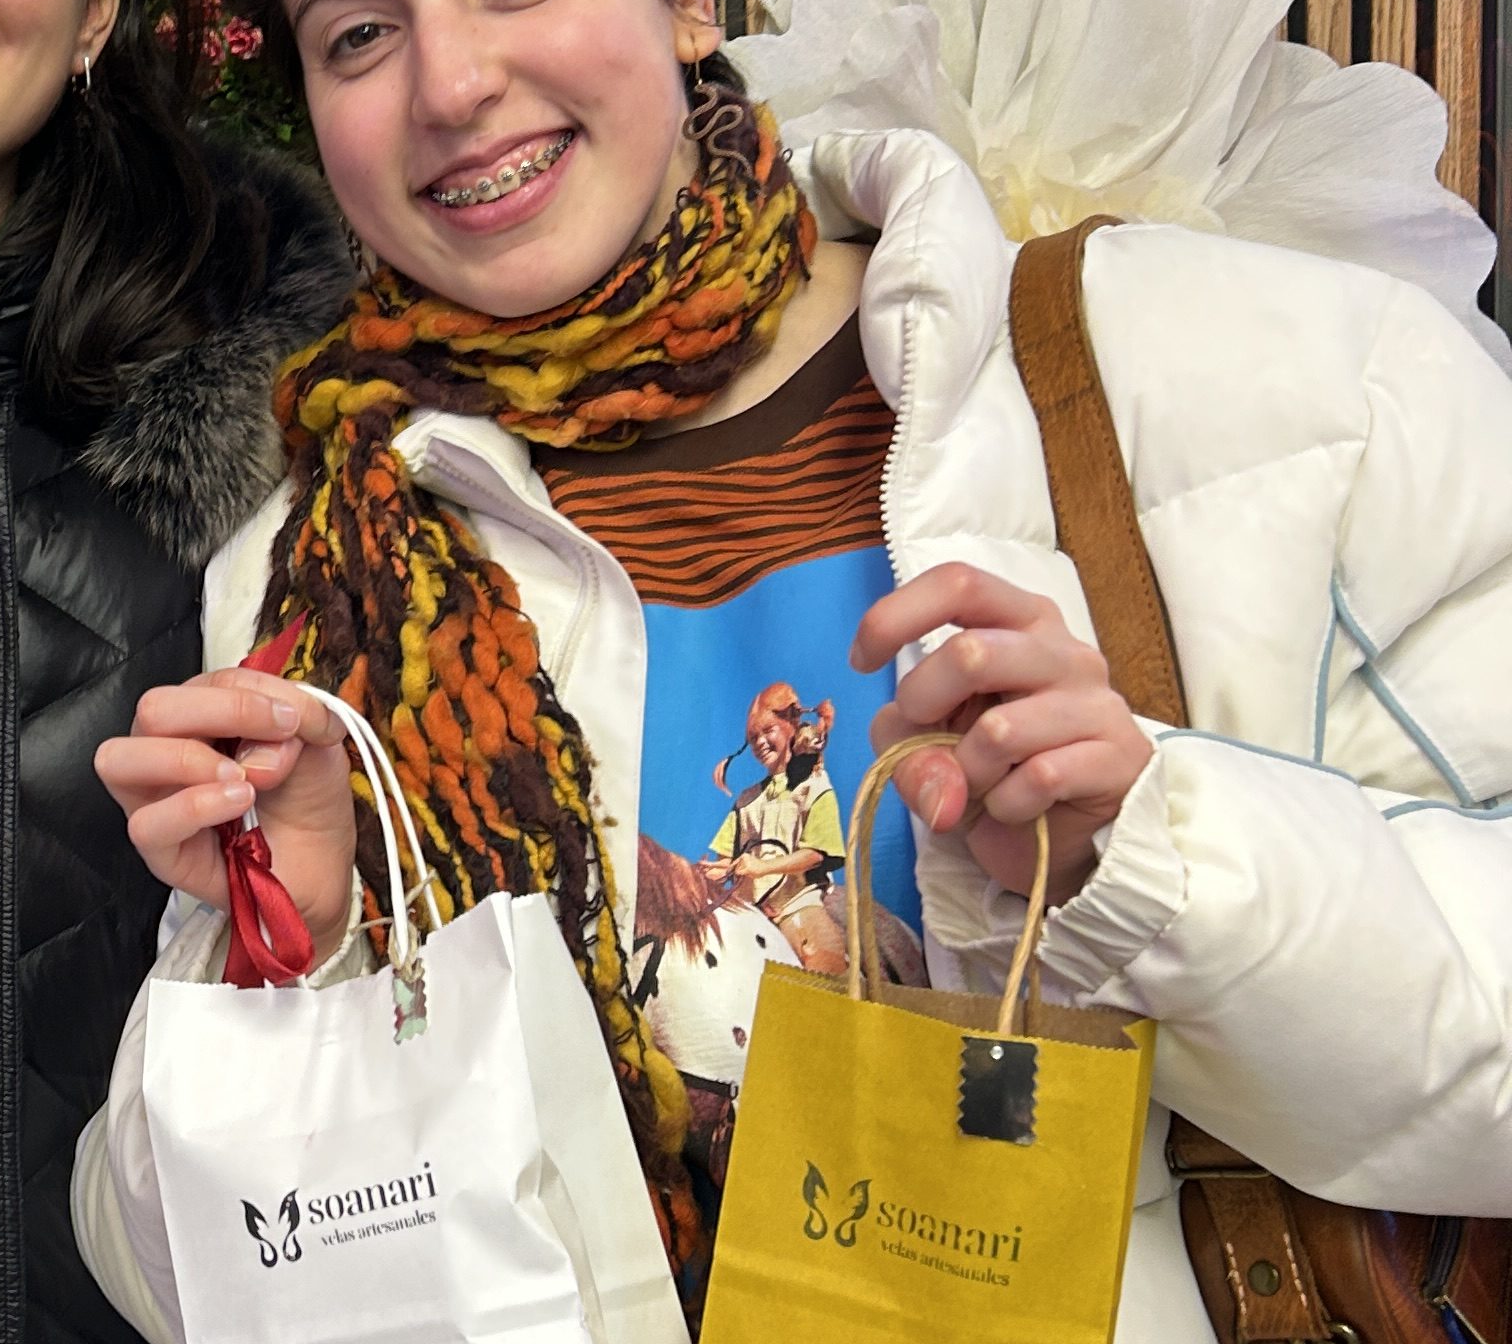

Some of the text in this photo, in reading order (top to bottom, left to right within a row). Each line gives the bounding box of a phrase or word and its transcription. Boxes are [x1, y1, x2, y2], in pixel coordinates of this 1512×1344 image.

[307, 1160, 438, 1225] soanari
[320, 1208, 438, 1247] velas artesanales
[875, 1200, 1024, 1263] soanari
[880, 1238, 1011, 1288] velas artesanales
